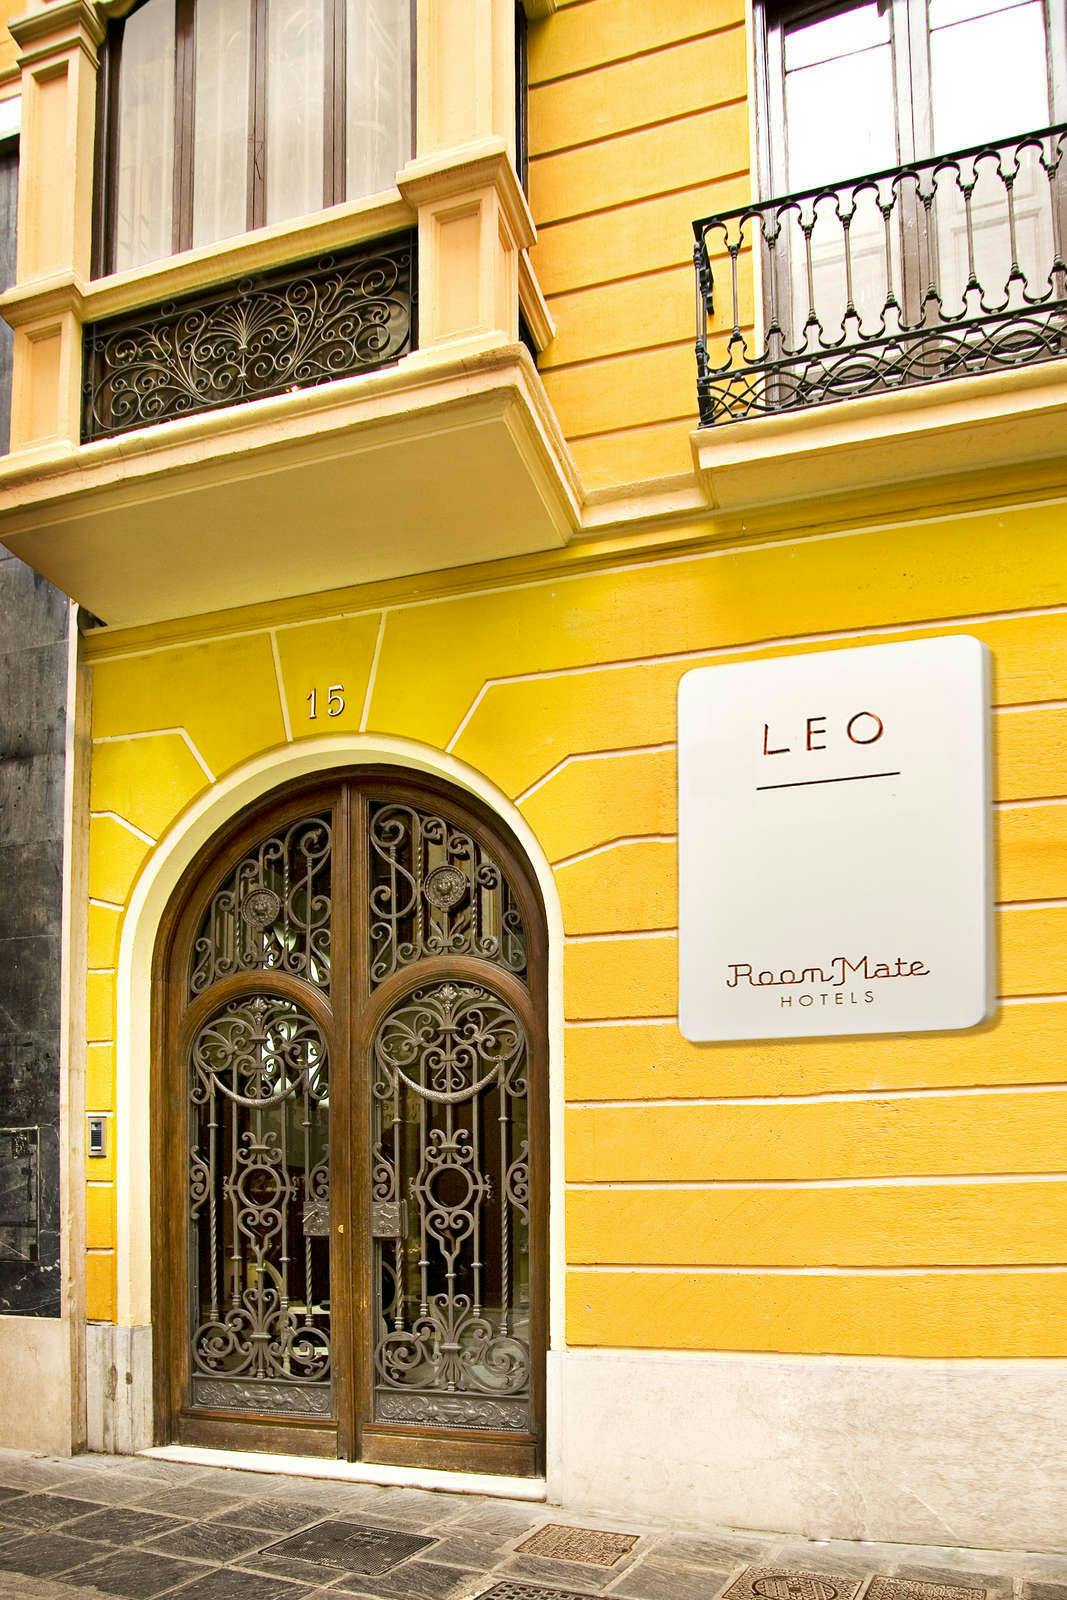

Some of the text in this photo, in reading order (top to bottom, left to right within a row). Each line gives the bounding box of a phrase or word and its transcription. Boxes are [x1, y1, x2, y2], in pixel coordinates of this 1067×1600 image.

[306, 684, 346, 720] 15
[763, 711, 884, 756] LEO
[780, 991, 874, 1008] HOTELS
